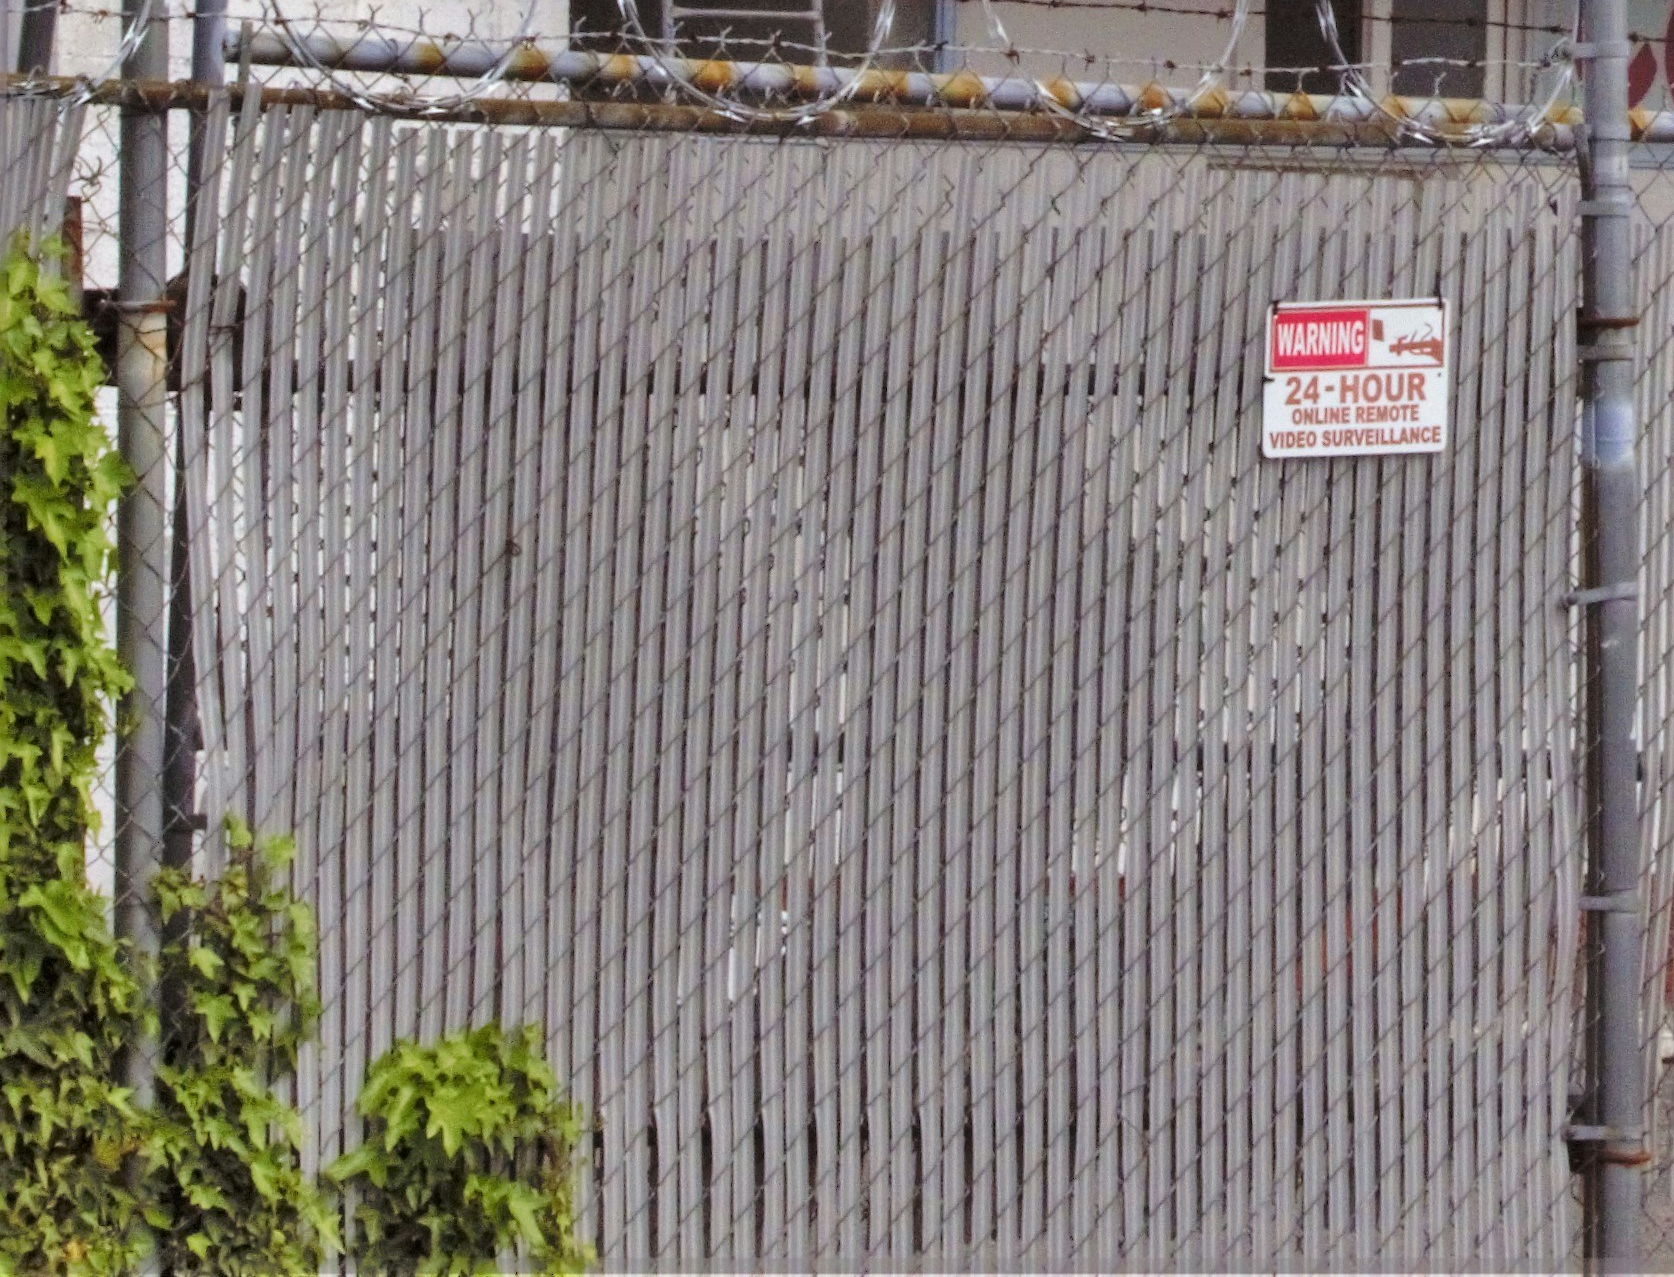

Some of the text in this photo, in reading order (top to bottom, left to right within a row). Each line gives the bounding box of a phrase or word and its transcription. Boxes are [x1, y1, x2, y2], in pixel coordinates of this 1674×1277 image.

[1277, 321, 1365, 356] WARNING
[1292, 404, 1420, 425] ONLINE REMOTE
[1270, 426, 1441, 449] VIDEO SURVEILLANCE
